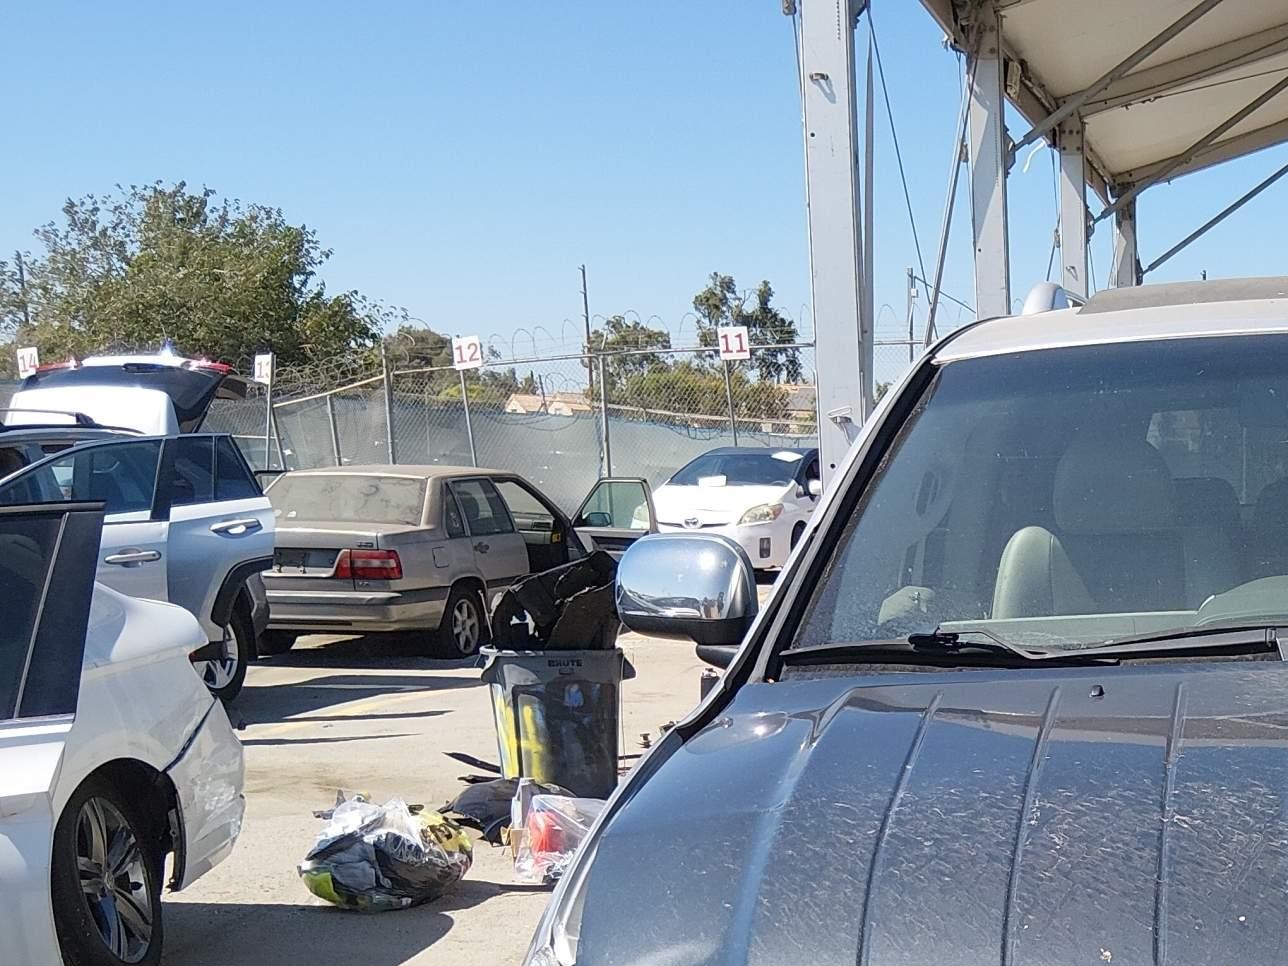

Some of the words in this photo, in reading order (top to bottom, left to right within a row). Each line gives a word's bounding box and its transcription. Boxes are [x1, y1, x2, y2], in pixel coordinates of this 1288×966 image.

[455, 342, 480, 364] 12
[720, 333, 748, 353] 11
[19, 353, 39, 373] 14
